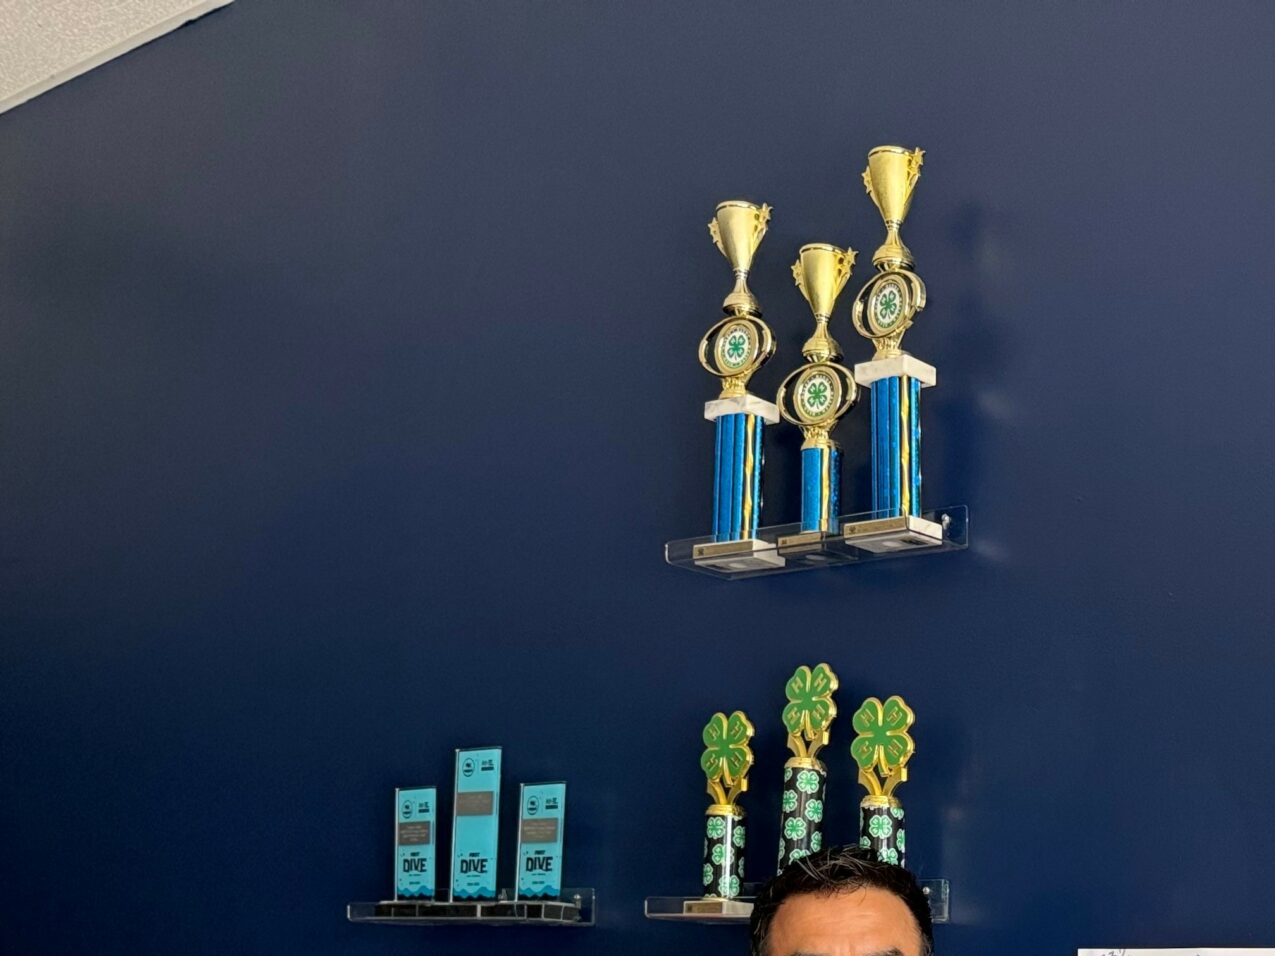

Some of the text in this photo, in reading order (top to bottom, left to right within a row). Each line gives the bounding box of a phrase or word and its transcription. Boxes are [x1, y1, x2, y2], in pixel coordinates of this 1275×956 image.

[403, 858, 427, 872] DIVE
[460, 859, 488, 874] DIVE
[526, 856, 553, 872] DIVE
